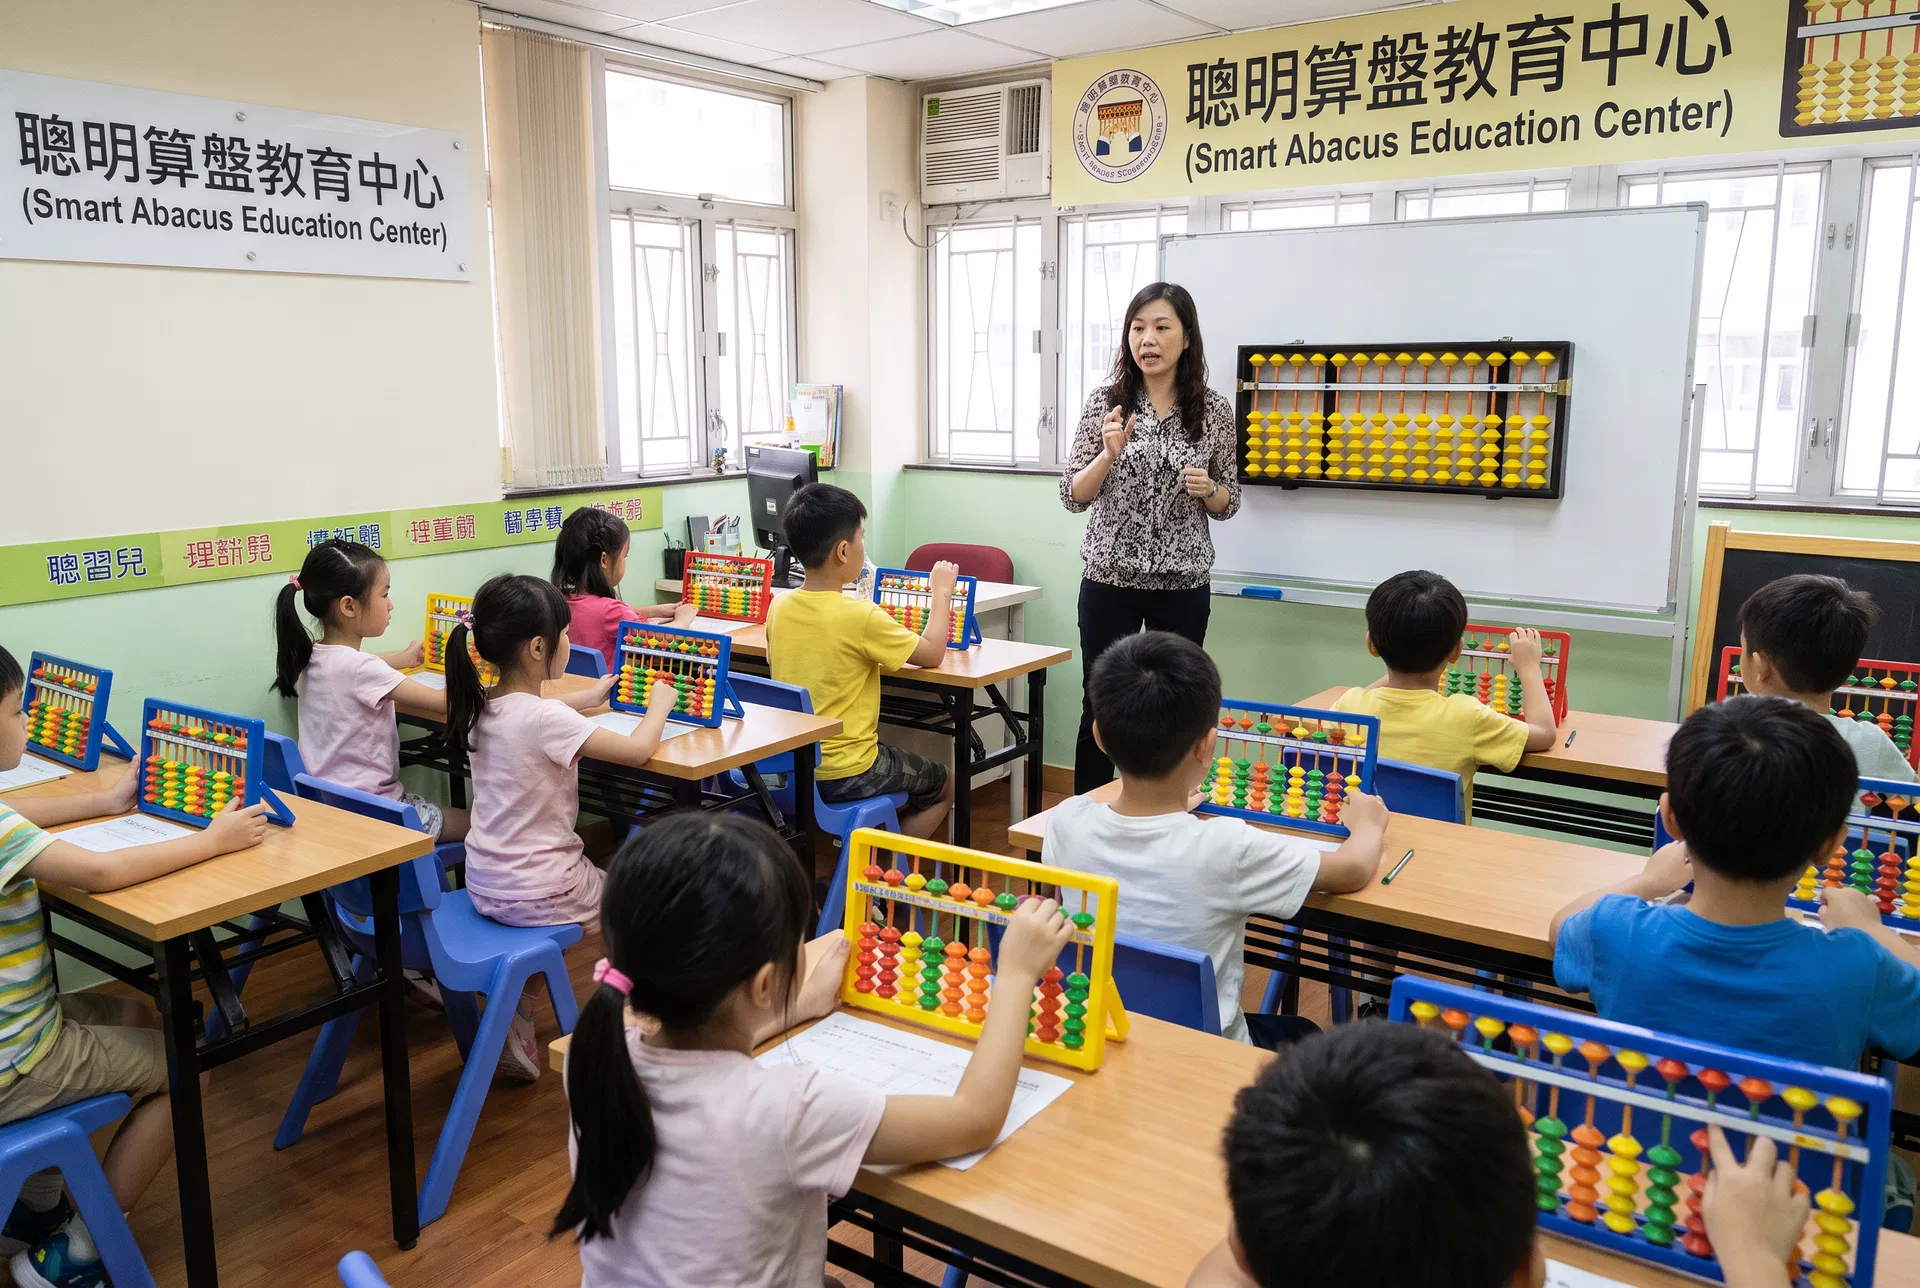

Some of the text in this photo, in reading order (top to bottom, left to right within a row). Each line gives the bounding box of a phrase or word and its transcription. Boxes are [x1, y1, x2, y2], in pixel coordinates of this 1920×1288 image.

[1185, 0, 1733, 130] 聰明算盤教育中心
[15, 111, 446, 209] 聰明算盤教育中心
[1185, 137, 1278, 184] (Smart
[1285, 131, 1399, 167] Abacus
[1410, 109, 1580, 155] Education
[1594, 88, 1733, 139] Center)
[22, 187, 447, 252] (Smart Abacus Education Center)
